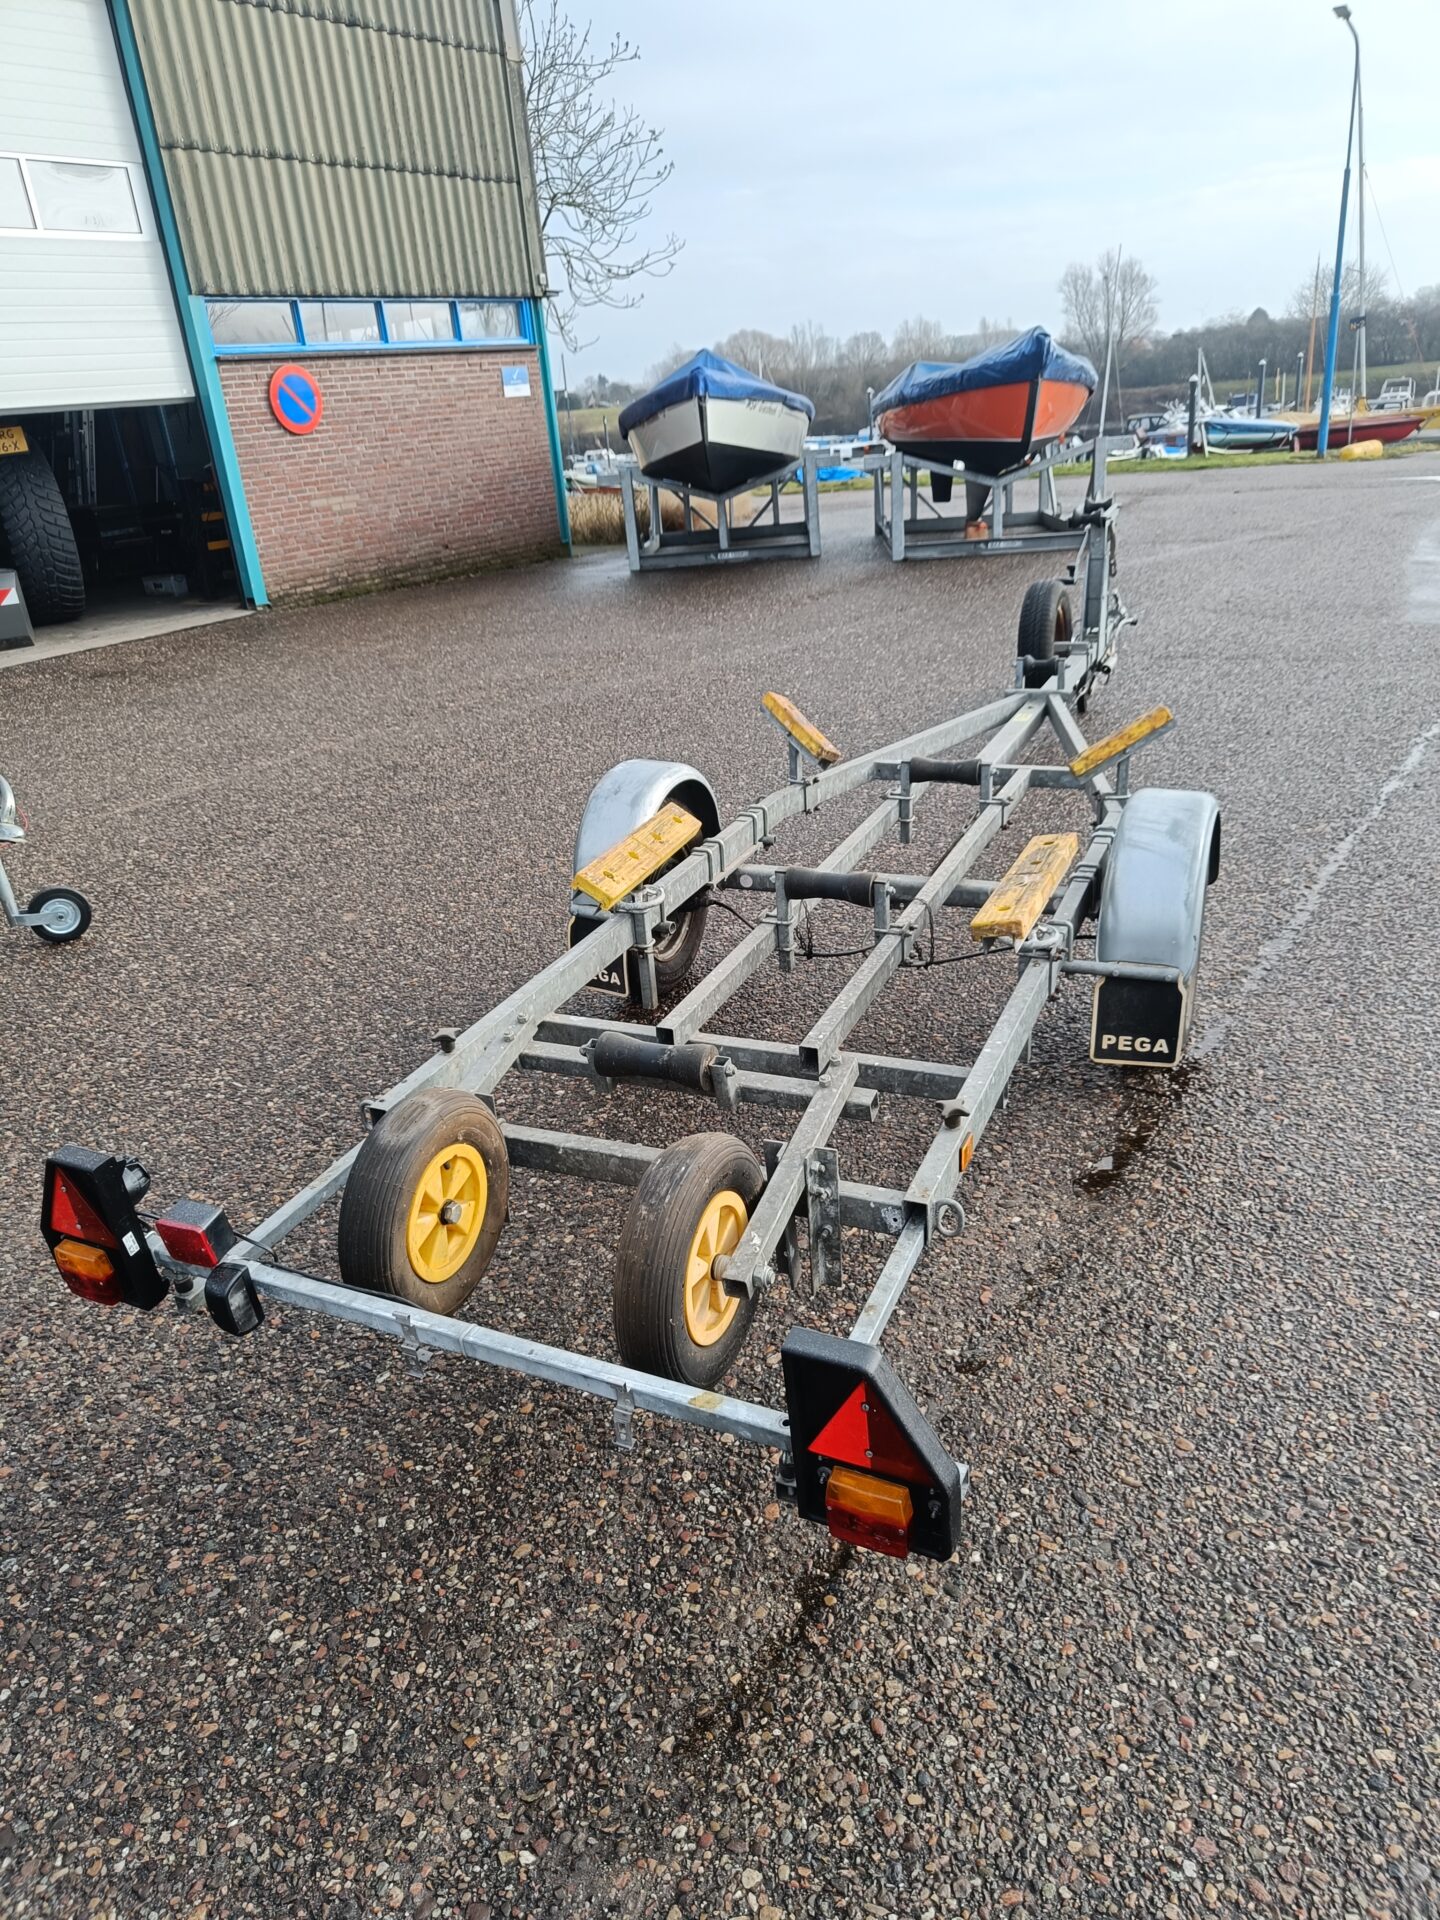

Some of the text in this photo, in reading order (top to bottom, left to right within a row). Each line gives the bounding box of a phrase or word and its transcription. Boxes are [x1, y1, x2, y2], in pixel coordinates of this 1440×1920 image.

[0, 440, 20, 452] 6-X
[592, 969, 621, 986] GA
[1101, 1034, 1170, 1054] PEGA
